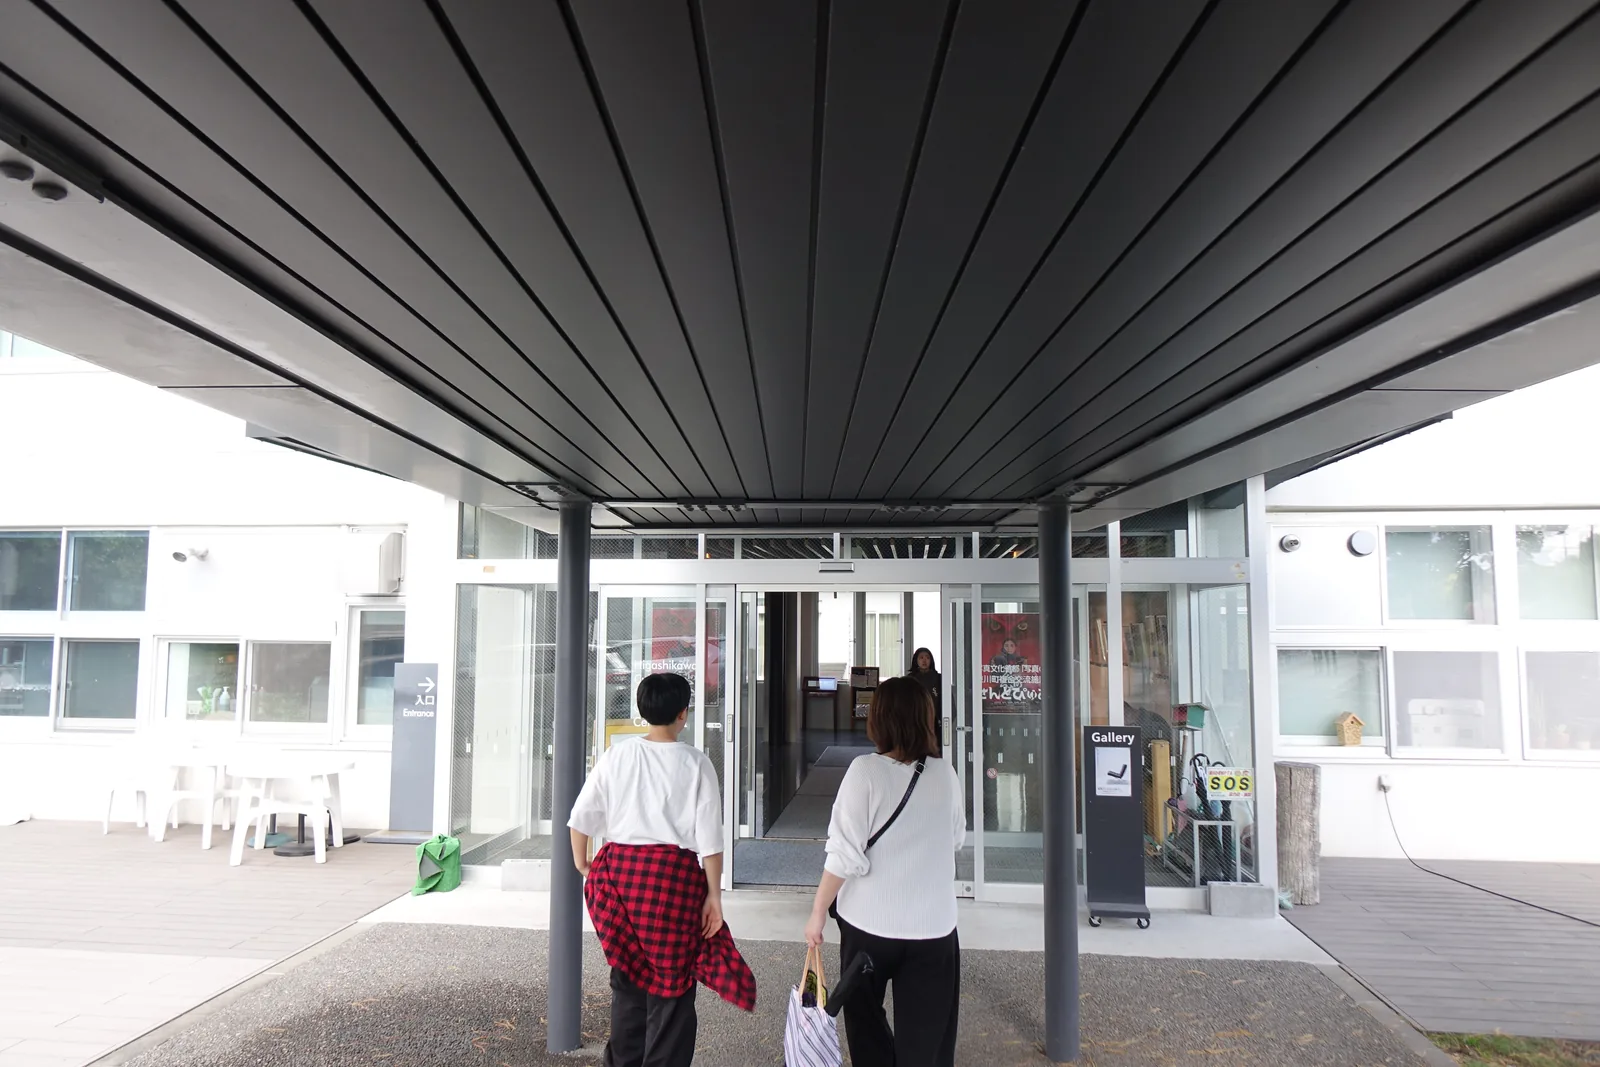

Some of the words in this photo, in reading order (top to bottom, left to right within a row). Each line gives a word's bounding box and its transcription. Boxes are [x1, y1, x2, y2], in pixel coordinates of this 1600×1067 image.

[415, 695, 435, 706] 入口
[403, 708, 434, 718] Entrance
[1091, 732, 1135, 746] Gallery
[1210, 776, 1249, 791] SOS
